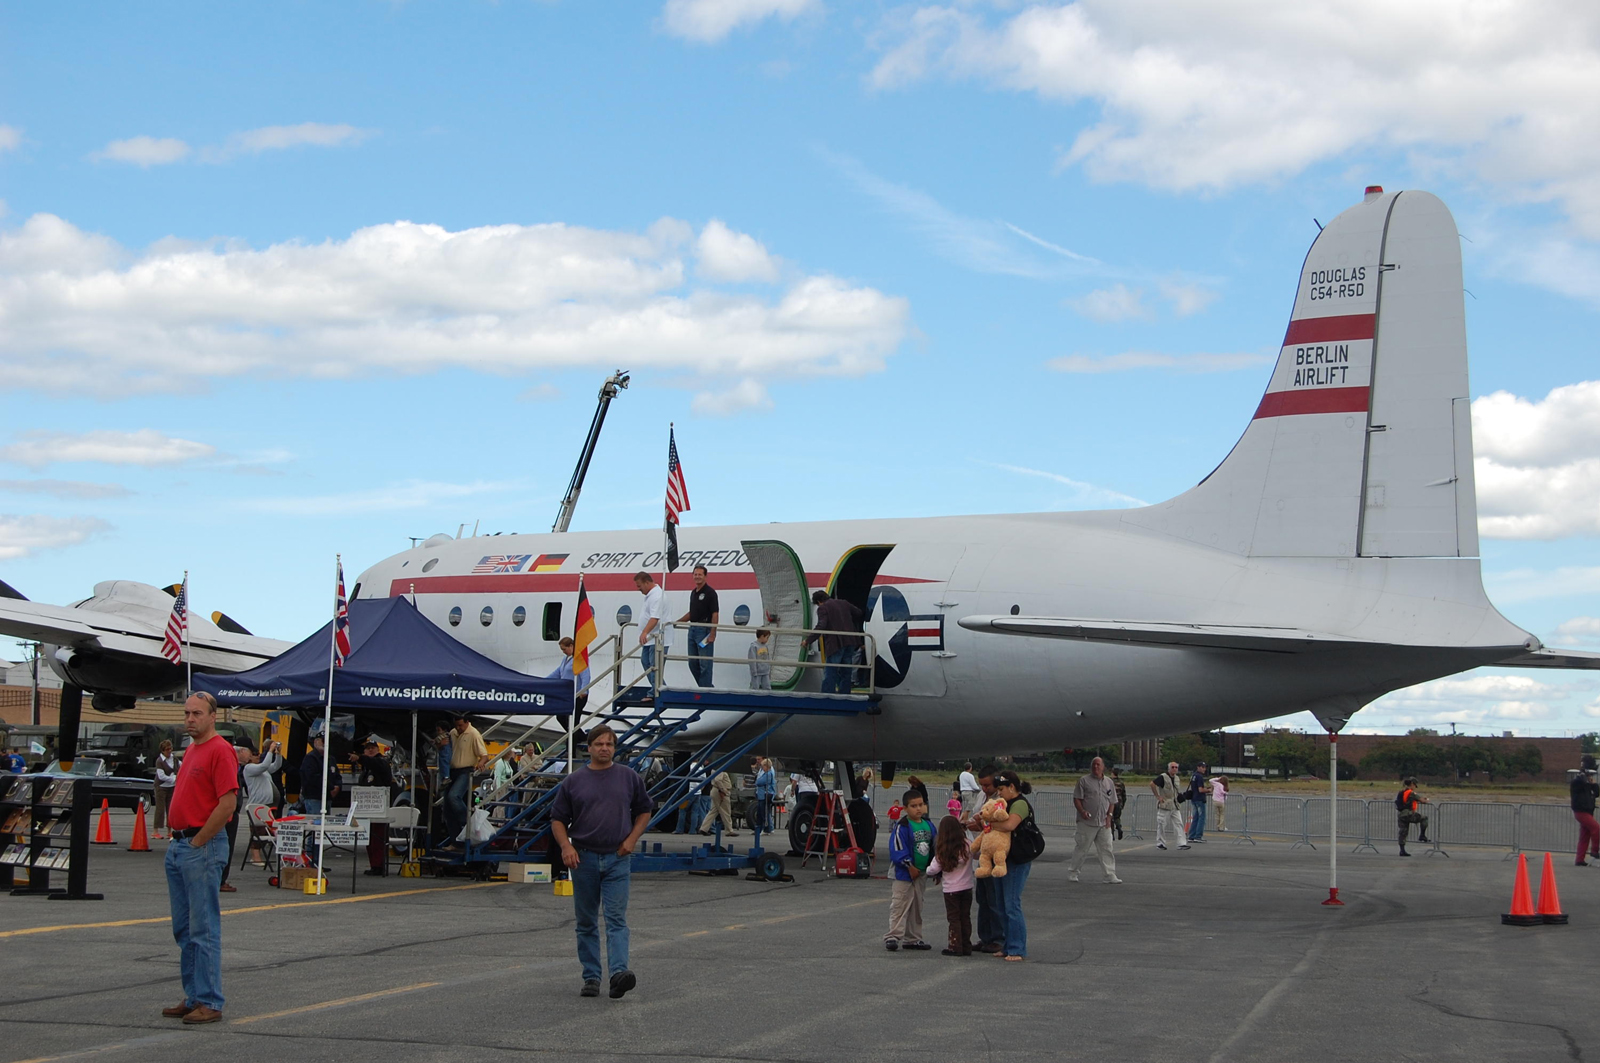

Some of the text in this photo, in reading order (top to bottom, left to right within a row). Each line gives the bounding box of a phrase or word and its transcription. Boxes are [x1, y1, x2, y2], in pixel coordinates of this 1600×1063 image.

[1311, 267, 1366, 285] DOUGLAS
[1310, 283, 1364, 300] C54-R5D
[1296, 344, 1349, 365] BERLIN
[1294, 366, 1349, 386] AIRLIFT
[581, 552, 643, 569] SPIRIT
[678, 550, 751, 567] FREEDO
[360, 686, 546, 706] www.spiritoffreedom.org
